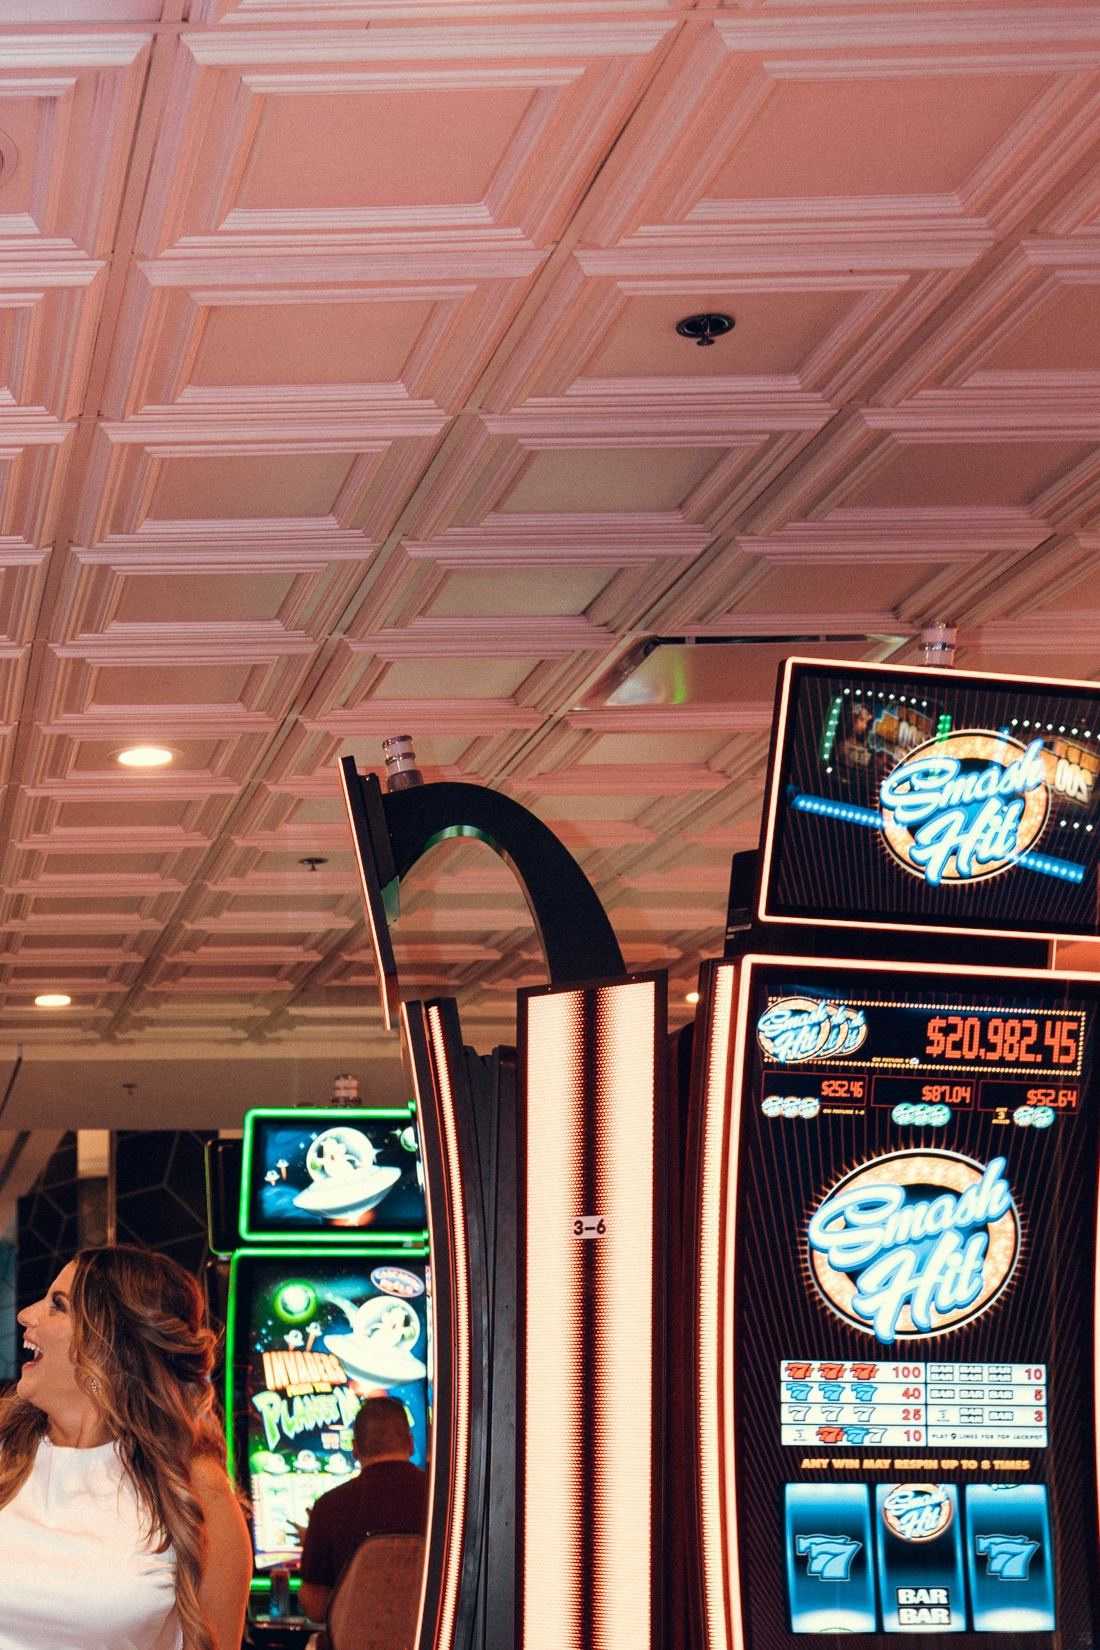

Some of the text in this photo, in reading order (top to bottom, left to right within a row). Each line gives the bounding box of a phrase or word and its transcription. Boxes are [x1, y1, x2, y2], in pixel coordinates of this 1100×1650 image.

[880, 738, 1046, 824] Smash
[909, 797, 1024, 887] Hit
[757, 999, 829, 1038] Smash
[772, 1025, 820, 1064] Hit
[925, 1016, 1078, 1064] $20,982.45
[821, 1080, 863, 1098] $252.46
[922, 1085, 971, 1103] $87.04
[1026, 1088, 1077, 1108] $52.64
[808, 1156, 1013, 1272] Smash
[573, 1219, 606, 1236] 3-6
[852, 1228, 990, 1345] Hit
[262, 1351, 347, 1390] INVADERS
[893, 1366, 921, 1379] 100
[1025, 1368, 1043, 1380] 10
[902, 1387, 921, 1400] 40
[1034, 1389, 1043, 1401] 5
[252, 1389, 341, 1451] PLANET
[902, 1408, 921, 1420] 25
[1034, 1410, 1043, 1422] 3
[904, 1430, 922, 1442] 10
[951, 1433, 957, 1441] 9
[801, 1458, 829, 1469] ANY
[831, 1458, 860, 1470] WIN
[863, 1458, 891, 1470] MAY
[894, 1459, 939, 1470] RESPIN
[941, 1459, 959, 1470] UP
[960, 1459, 978, 1470] TO
[993, 1459, 1030, 1470] TIMES
[900, 1505, 941, 1540] Hit
[897, 1587, 948, 1604] BAR
[899, 1607, 950, 1625] BAR
